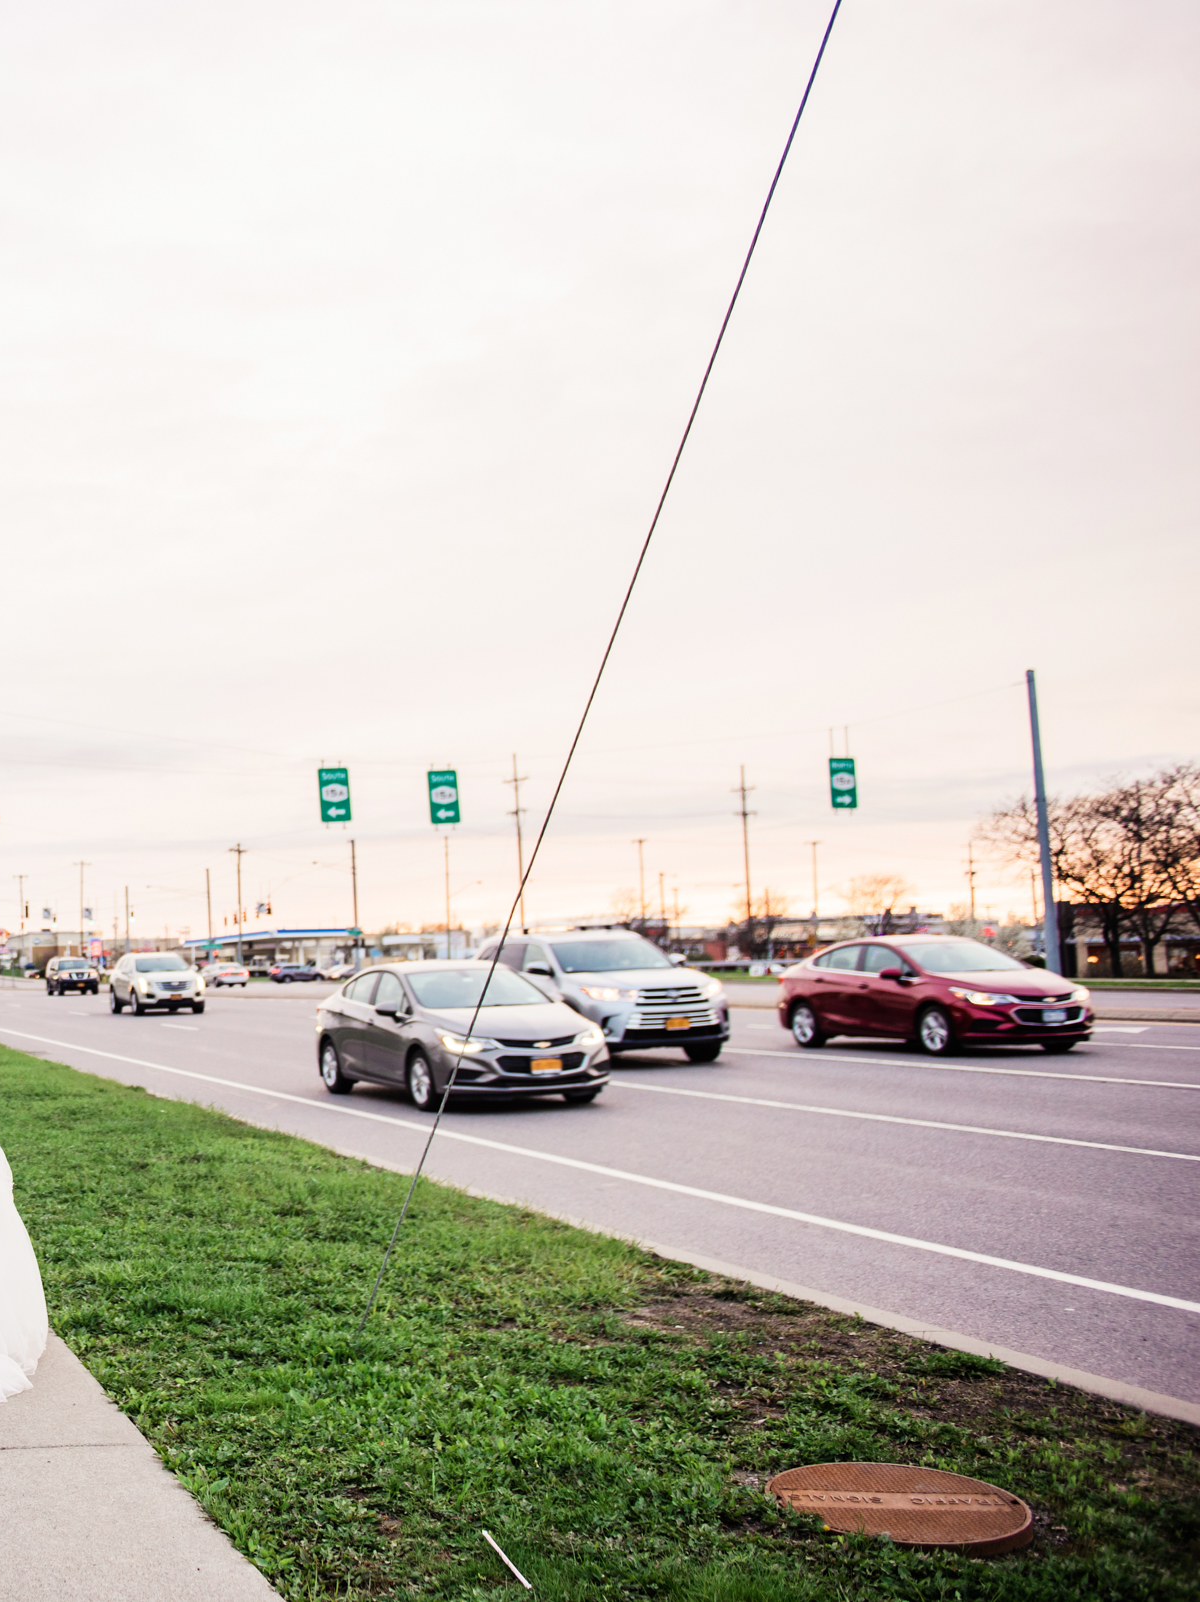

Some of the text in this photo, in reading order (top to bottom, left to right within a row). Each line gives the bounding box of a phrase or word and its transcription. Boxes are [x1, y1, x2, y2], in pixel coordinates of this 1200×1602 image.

[321, 772, 345, 780] SOUTH
[431, 775, 454, 783] SOUTH
[324, 789, 344, 798] 15A
[434, 791, 453, 800] 15A
[787, 1493, 1006, 1507] TRAFFIC SIGNALS
